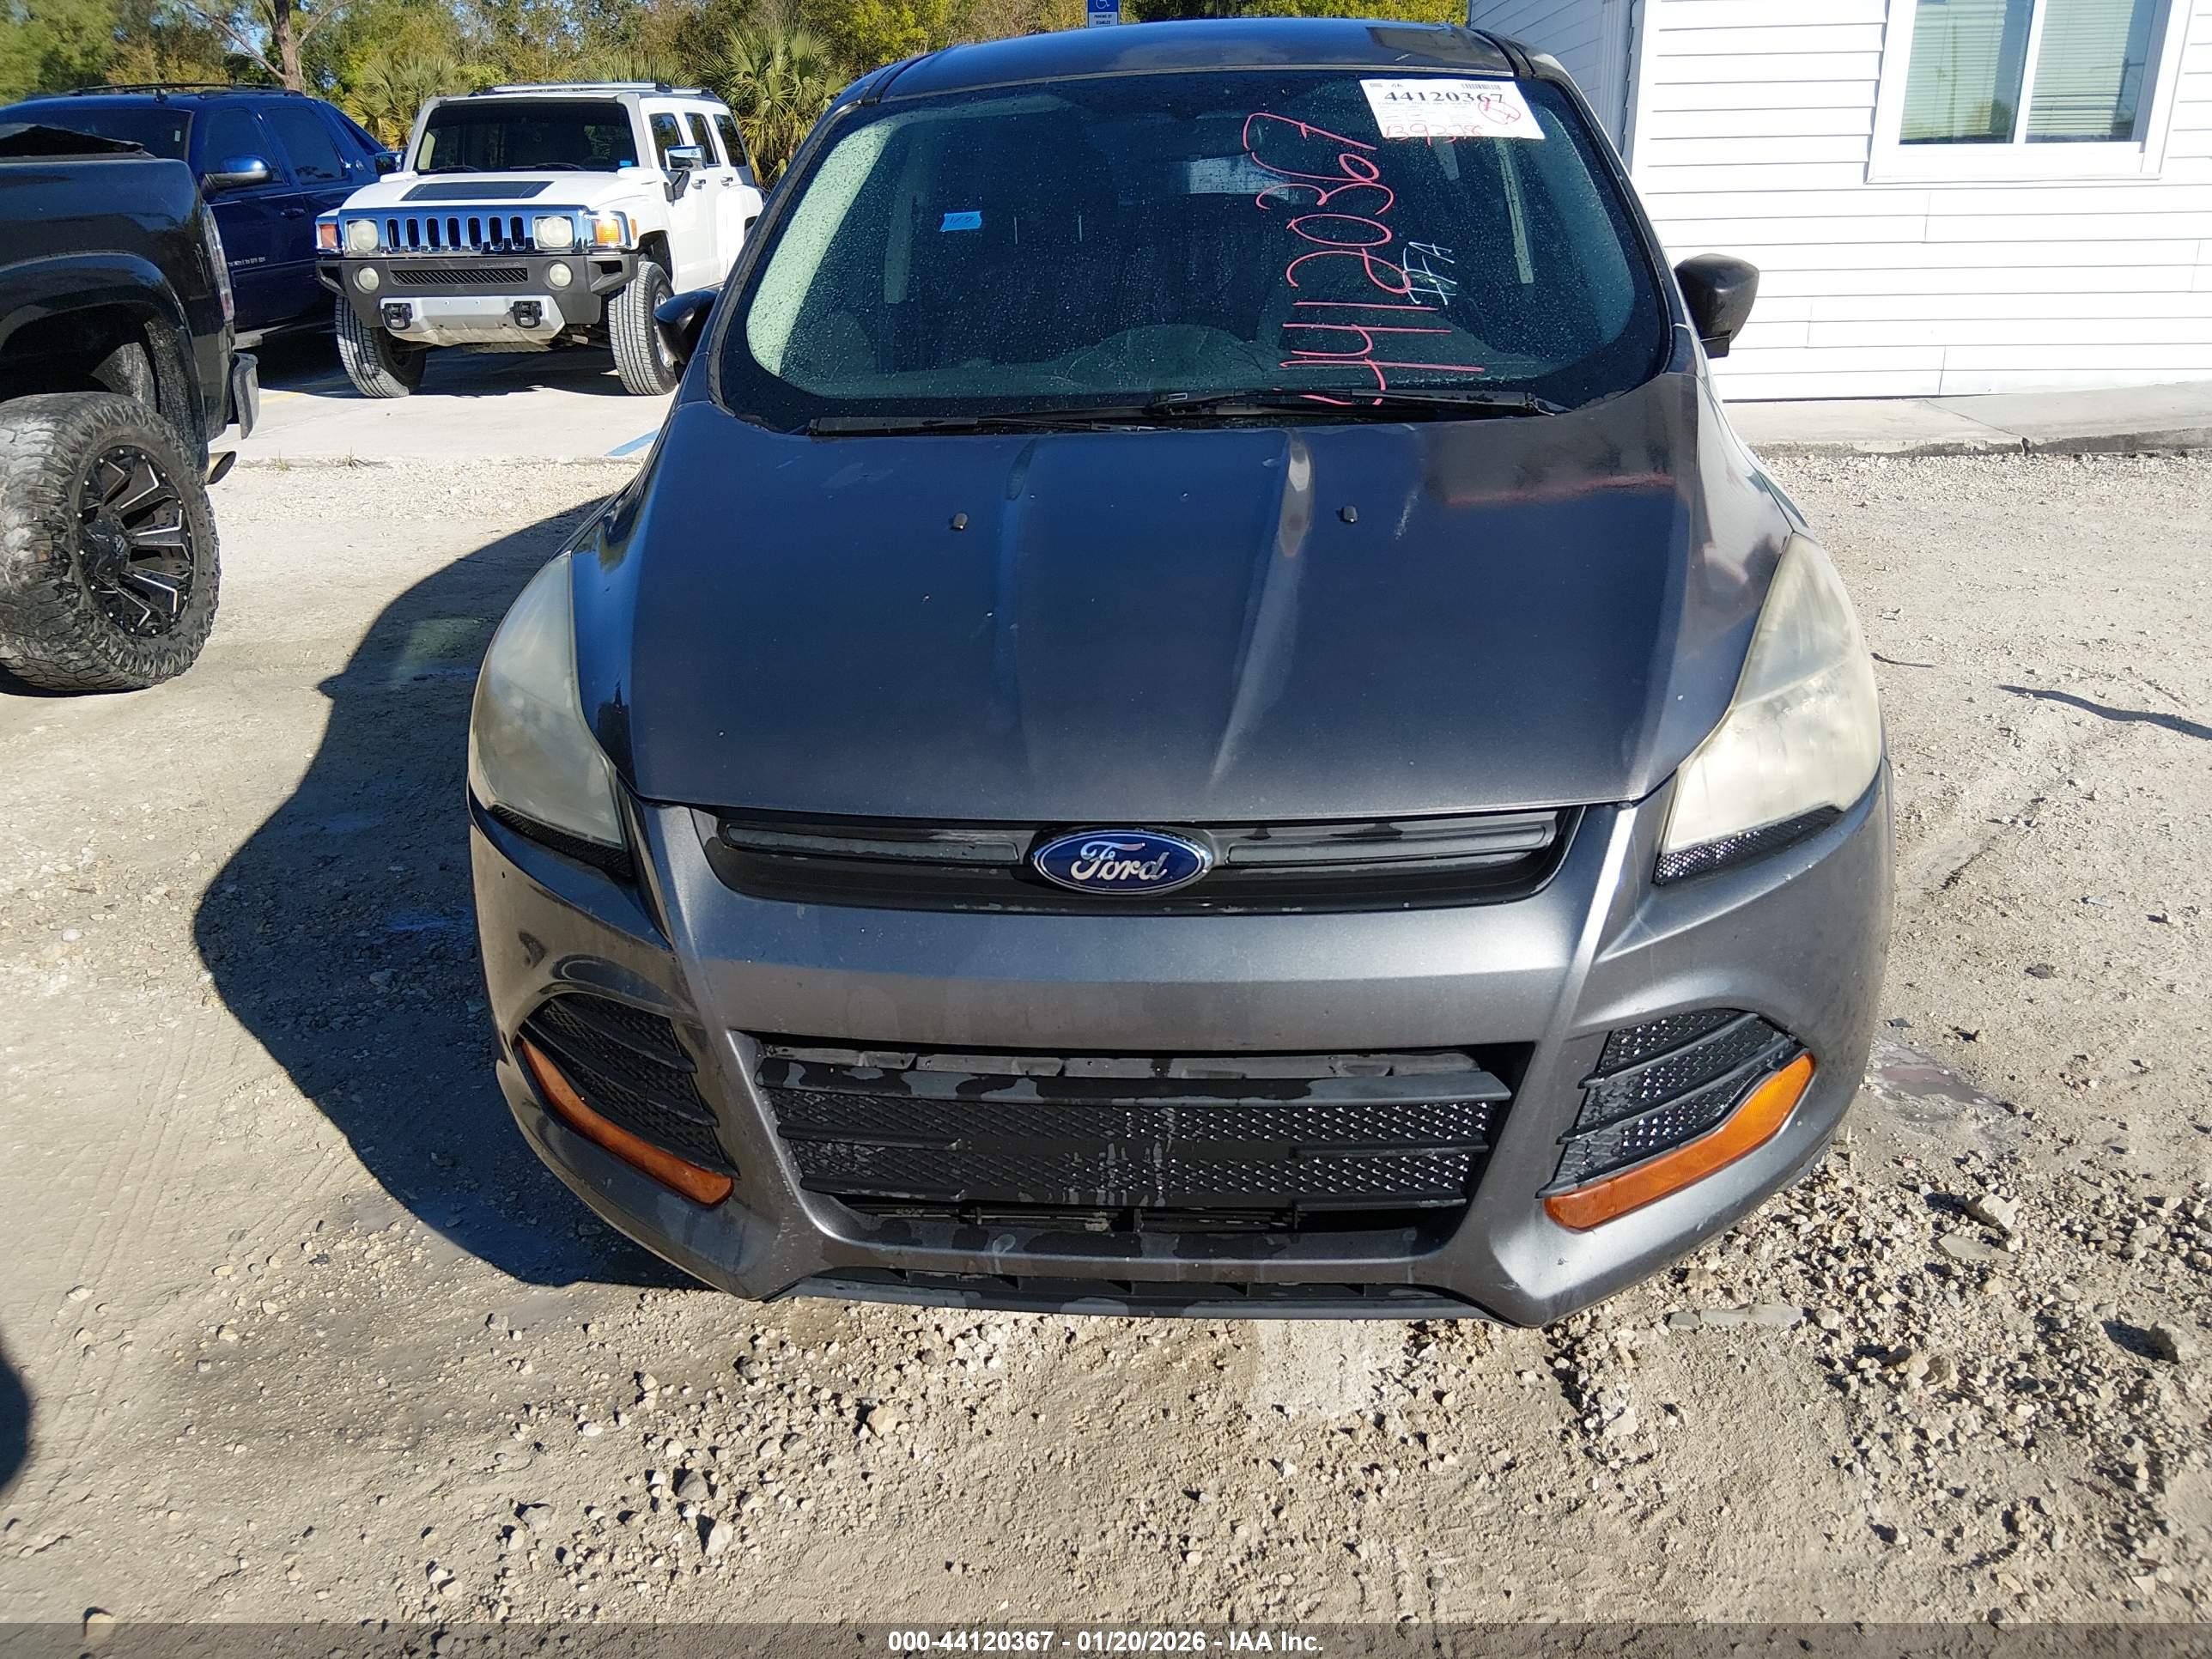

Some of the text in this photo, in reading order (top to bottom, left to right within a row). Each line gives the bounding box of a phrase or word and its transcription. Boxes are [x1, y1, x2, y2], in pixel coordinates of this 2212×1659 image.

[1383, 91, 1504, 104] 44120367
[1243, 112, 1486, 405] 44120367
[1070, 841, 1170, 881] Ford
